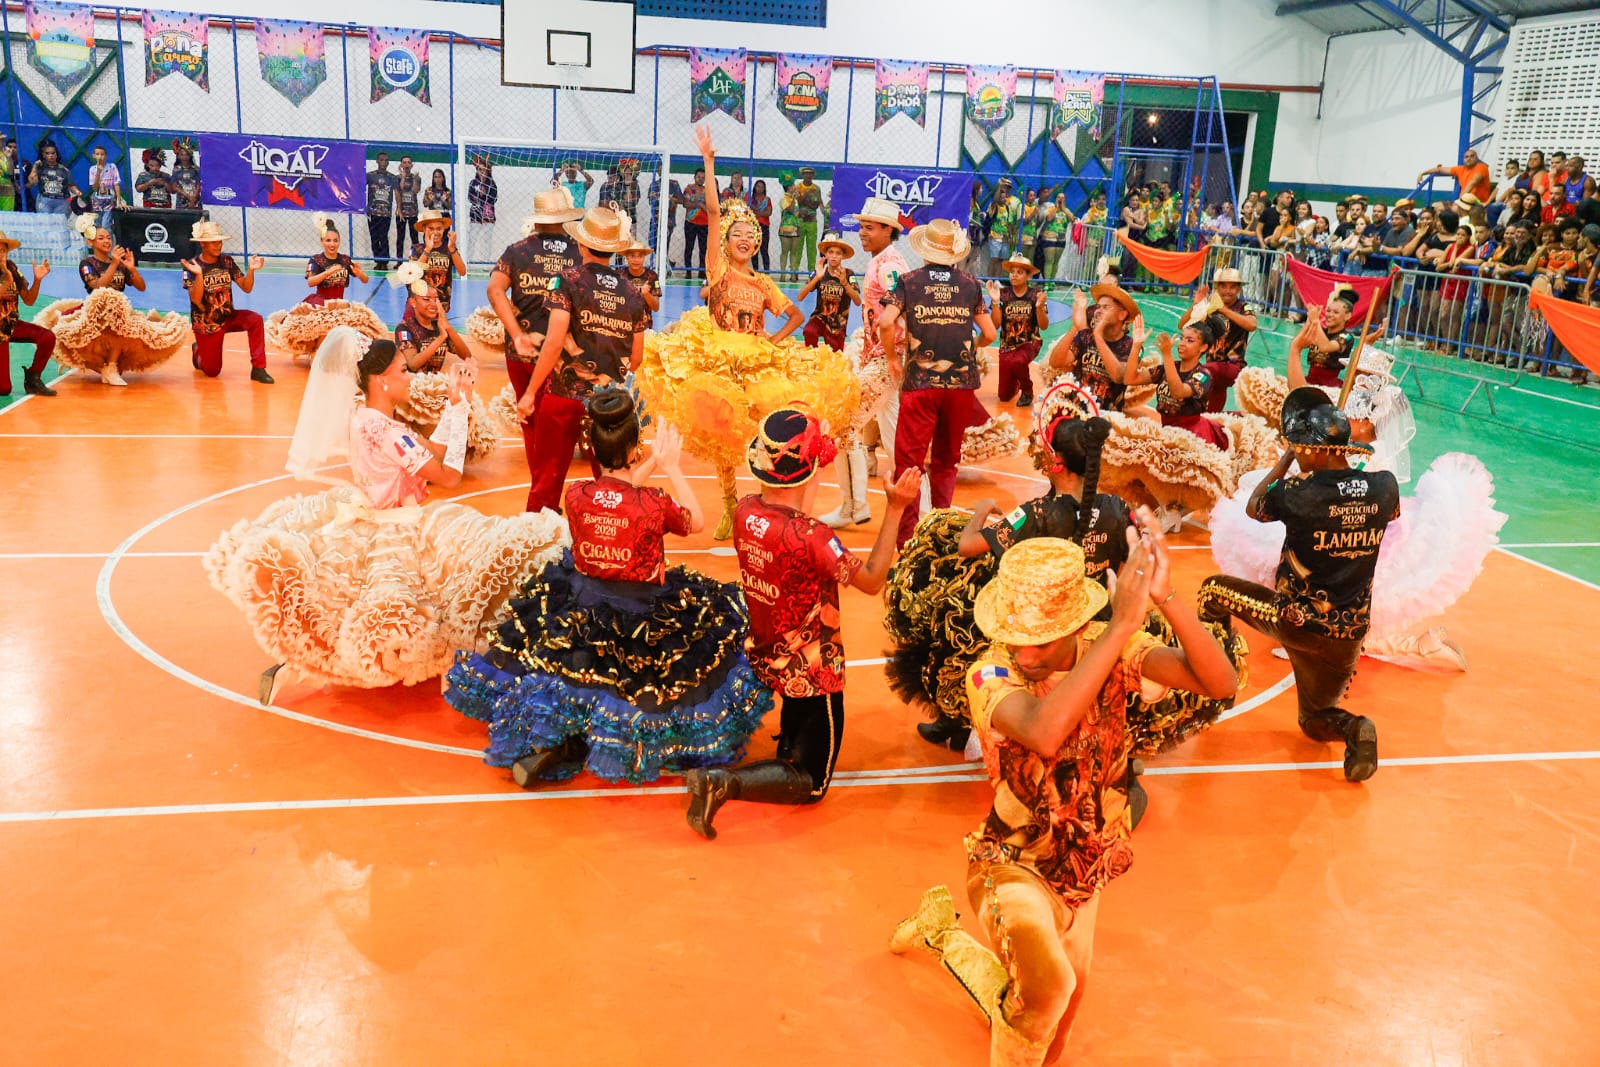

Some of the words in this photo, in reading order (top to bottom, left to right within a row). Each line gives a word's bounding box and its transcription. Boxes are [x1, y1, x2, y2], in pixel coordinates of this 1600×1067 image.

[251, 146, 323, 174] LIQAL
[875, 177, 935, 202] LIQAL
[913, 304, 970, 319] DANÇARINOS
[1342, 514, 1366, 525] 2026
[594, 524, 617, 536] 2026
[580, 541, 632, 561] CIGANO
[741, 569, 780, 599] CIGANO
